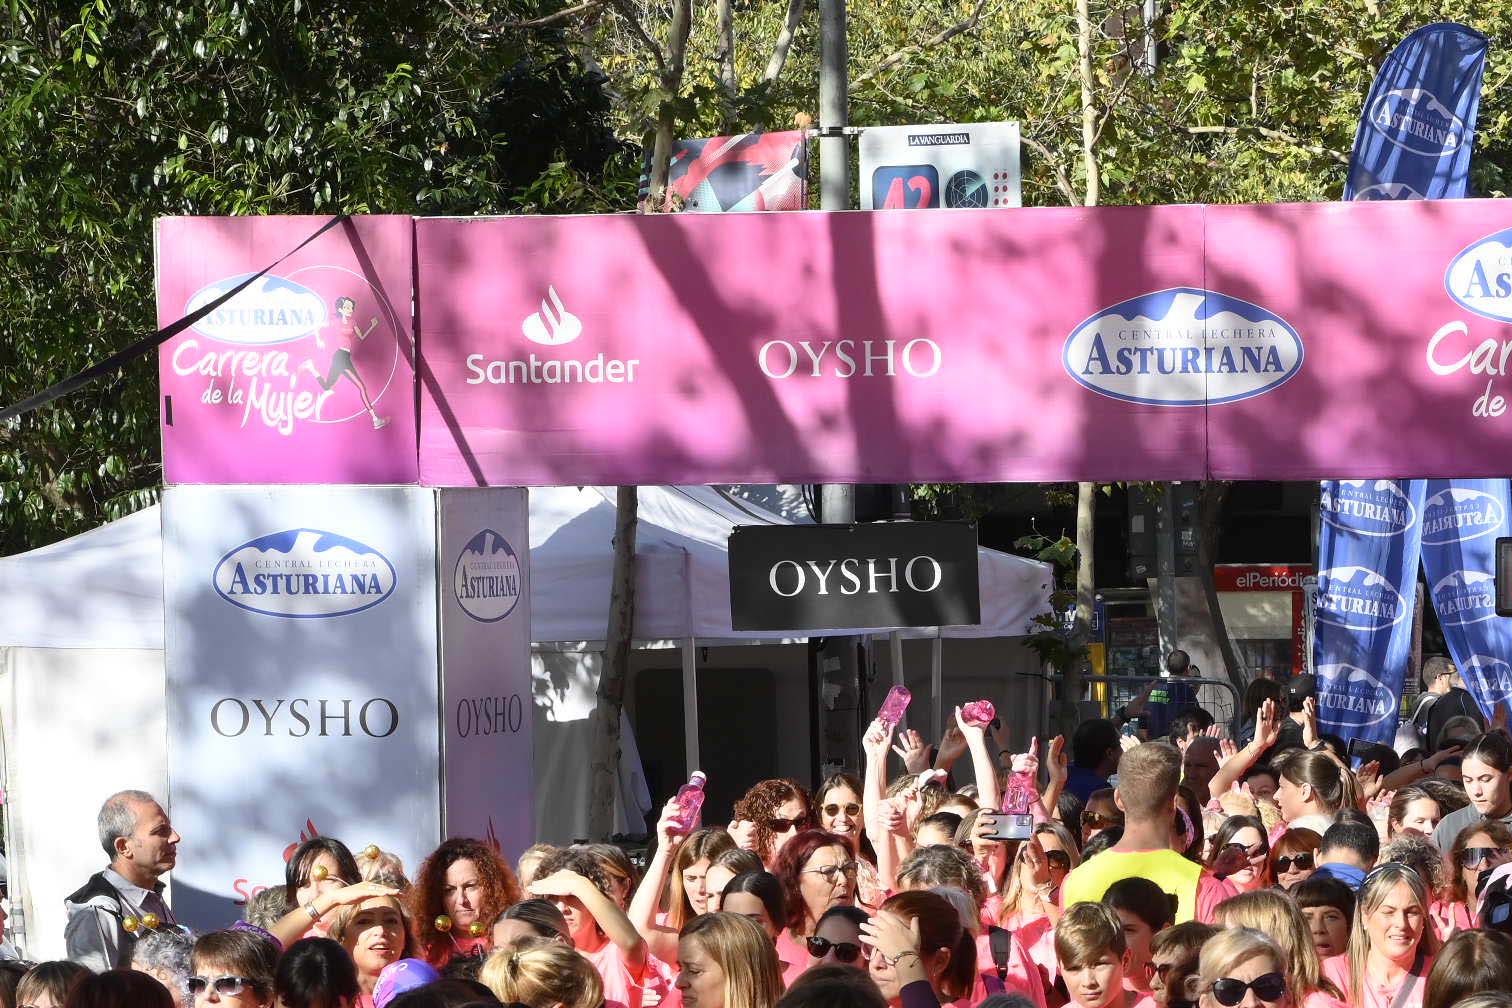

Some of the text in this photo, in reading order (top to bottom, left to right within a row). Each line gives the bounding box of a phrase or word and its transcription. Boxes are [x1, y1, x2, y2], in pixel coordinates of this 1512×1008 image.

[1376, 100, 1457, 148] ASTURIANA
[1081, 332, 1286, 376] ASTURIANA
[1118, 327, 1277, 341] CENTRAL LECHERA
[171, 339, 290, 377] Carrera
[465, 351, 640, 386] Santander
[757, 337, 943, 380] OYSHO
[200, 375, 336, 437] de la Mujer
[1472, 380, 1508, 418] de
[227, 562, 384, 596] ASTURIANA
[254, 559, 378, 569] CENTRAL LECHERA
[459, 564, 518, 600] ASTURIANA
[768, 554, 943, 598] OYSHO
[209, 696, 400, 740] OYSHO
[456, 694, 523, 739] OYSHO
